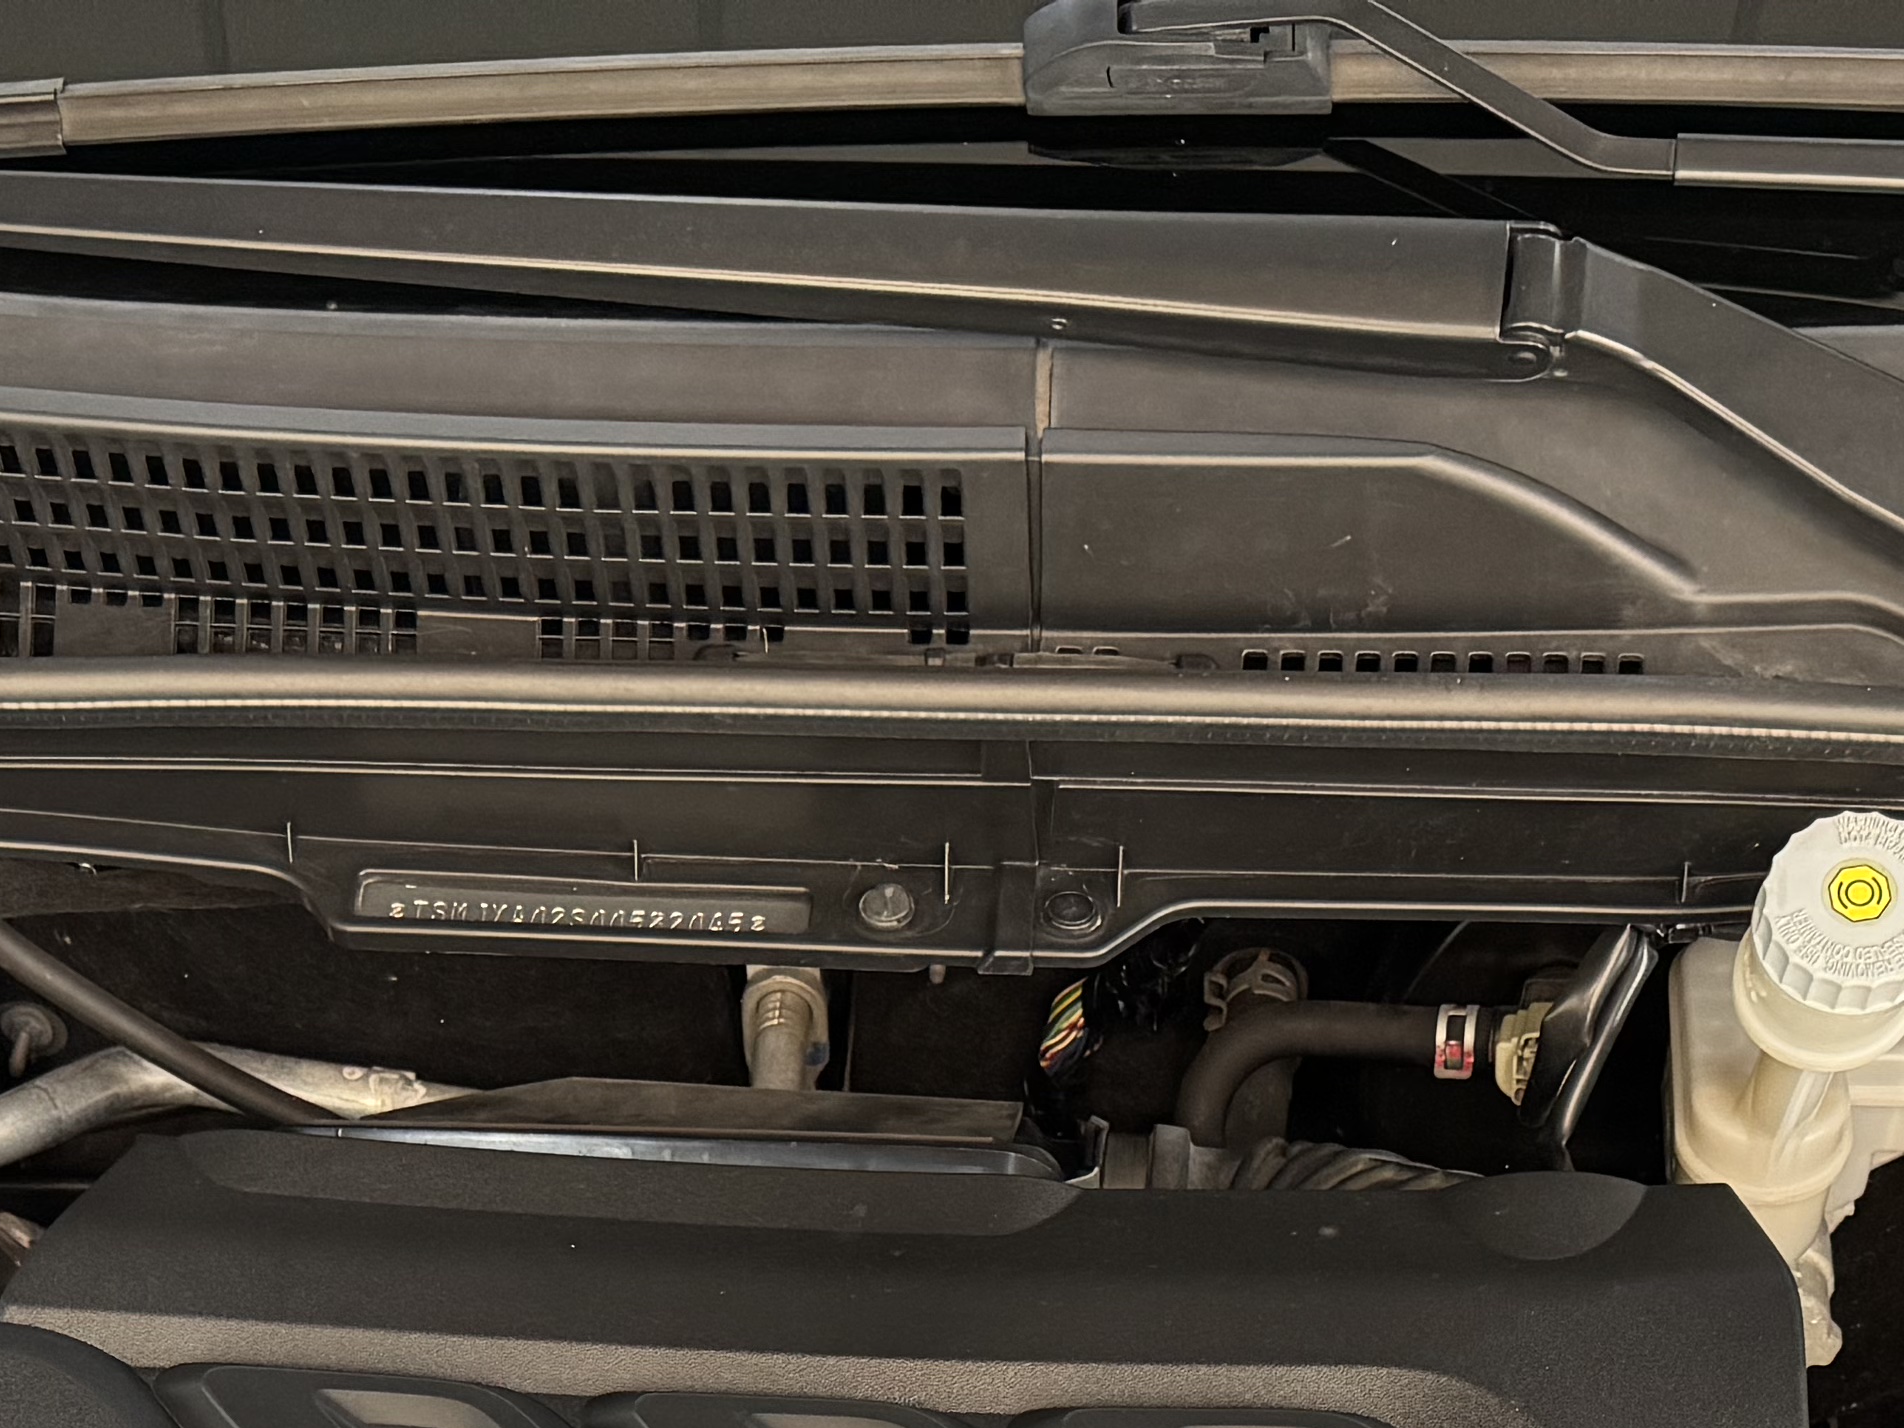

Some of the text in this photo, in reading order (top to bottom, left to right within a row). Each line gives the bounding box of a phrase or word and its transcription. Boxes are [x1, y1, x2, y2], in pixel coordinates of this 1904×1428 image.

[1773, 914, 1804, 945] ONLY
[1790, 907, 1853, 960] CONTAINER
[1798, 942, 1821, 966] USE
[1855, 936, 1904, 962] SEALED
